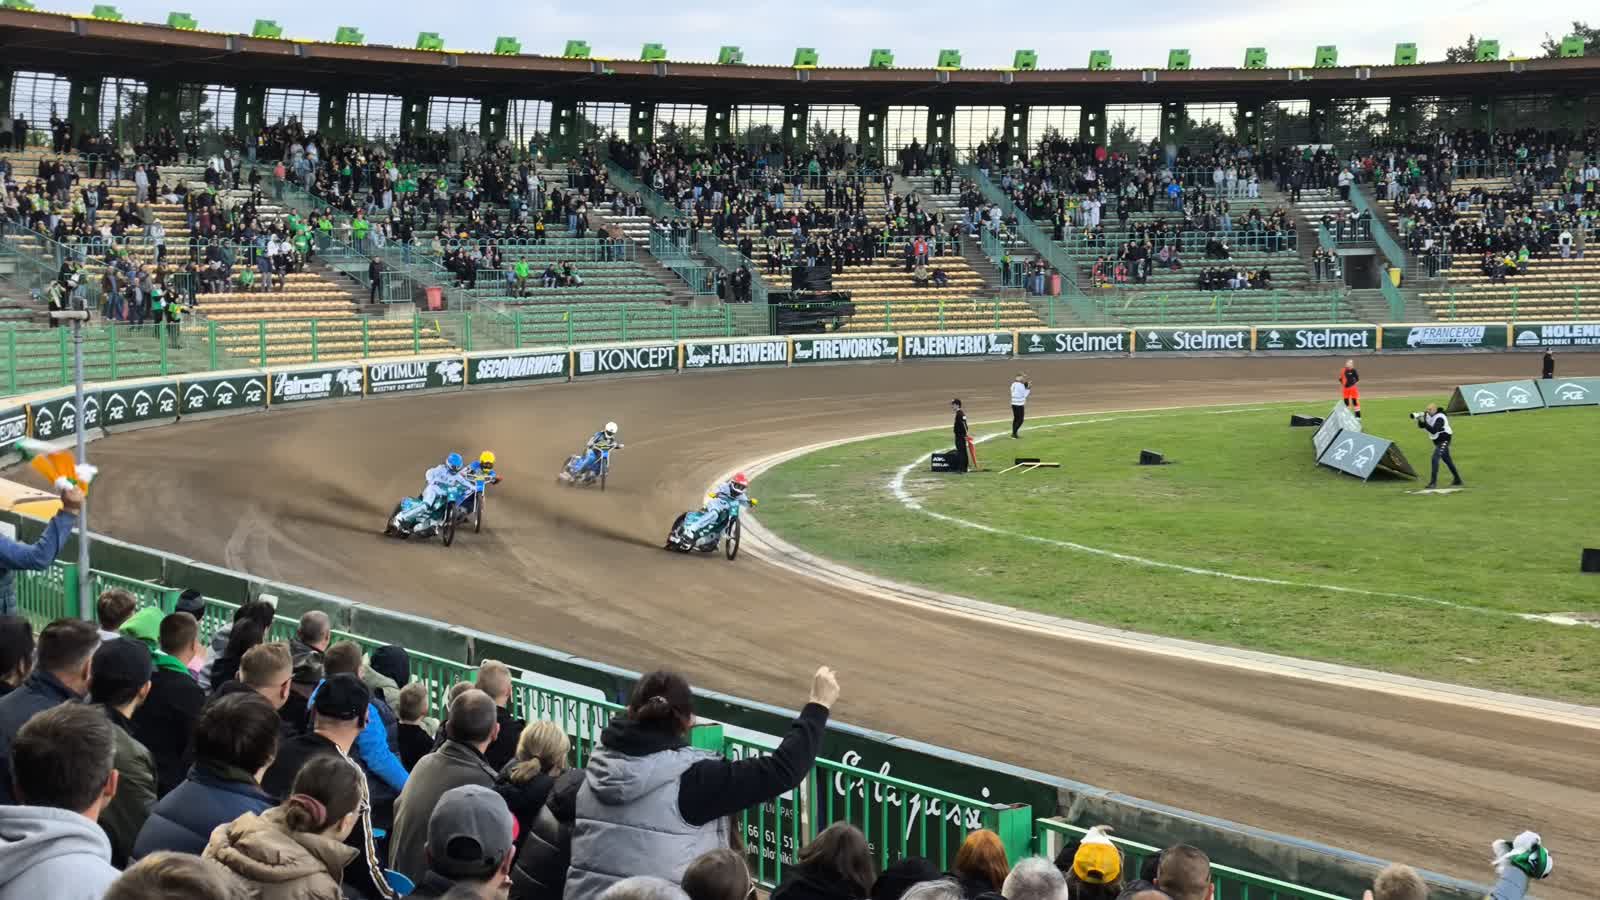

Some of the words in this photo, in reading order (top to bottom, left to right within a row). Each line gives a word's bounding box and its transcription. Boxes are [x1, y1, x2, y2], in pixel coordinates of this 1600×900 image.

[1055, 331, 1124, 352] Stelmet
[1173, 330, 1244, 350] Stelmet
[1295, 328, 1369, 348] Stelmet
[1423, 327, 1482, 338] FRANCEPOL
[1541, 338, 1571, 346] DOMKI
[711, 342, 787, 365] FAJERWERKI
[812, 338, 882, 360] FIREWORKS
[905, 335, 987, 356] FAJERWERKI
[598, 346, 676, 371] KONCEPT
[370, 362, 428, 381] OPTIMUM
[188, 395, 204, 408] PGE
[217, 392, 233, 405] PGE
[245, 389, 262, 402] PGE
[1480, 397, 1496, 408] PGE
[1511, 394, 1529, 404] PGE
[1562, 391, 1585, 400] PGE
[109, 406, 124, 420] PGE
[135, 402, 149, 416] PGE
[159, 399, 174, 413] PGE
